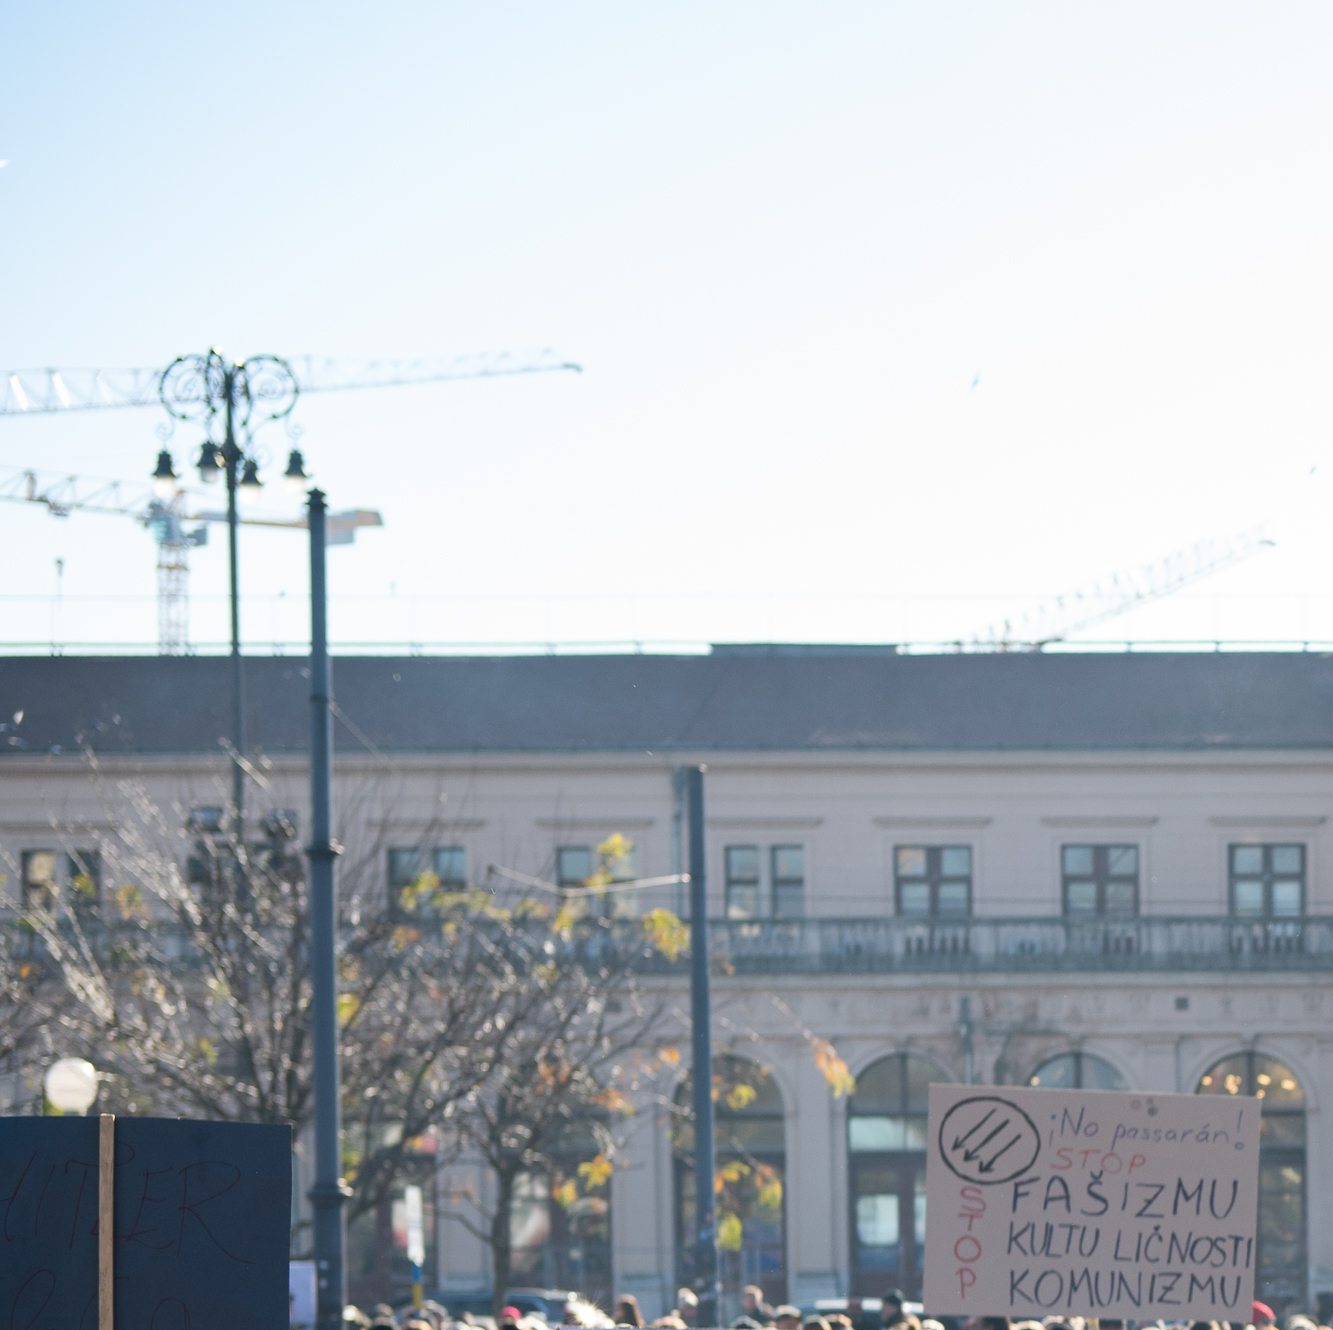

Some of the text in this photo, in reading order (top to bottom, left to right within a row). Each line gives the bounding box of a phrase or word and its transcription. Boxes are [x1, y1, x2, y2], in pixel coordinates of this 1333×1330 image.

[1050, 1148, 1147, 1175] STOP
[1012, 1169, 1239, 1220] FAŠIZMU
[1007, 1220, 1253, 1270] KULTU LIČNOSTI
[1009, 1266, 1242, 1309] KOMUNIZMU
